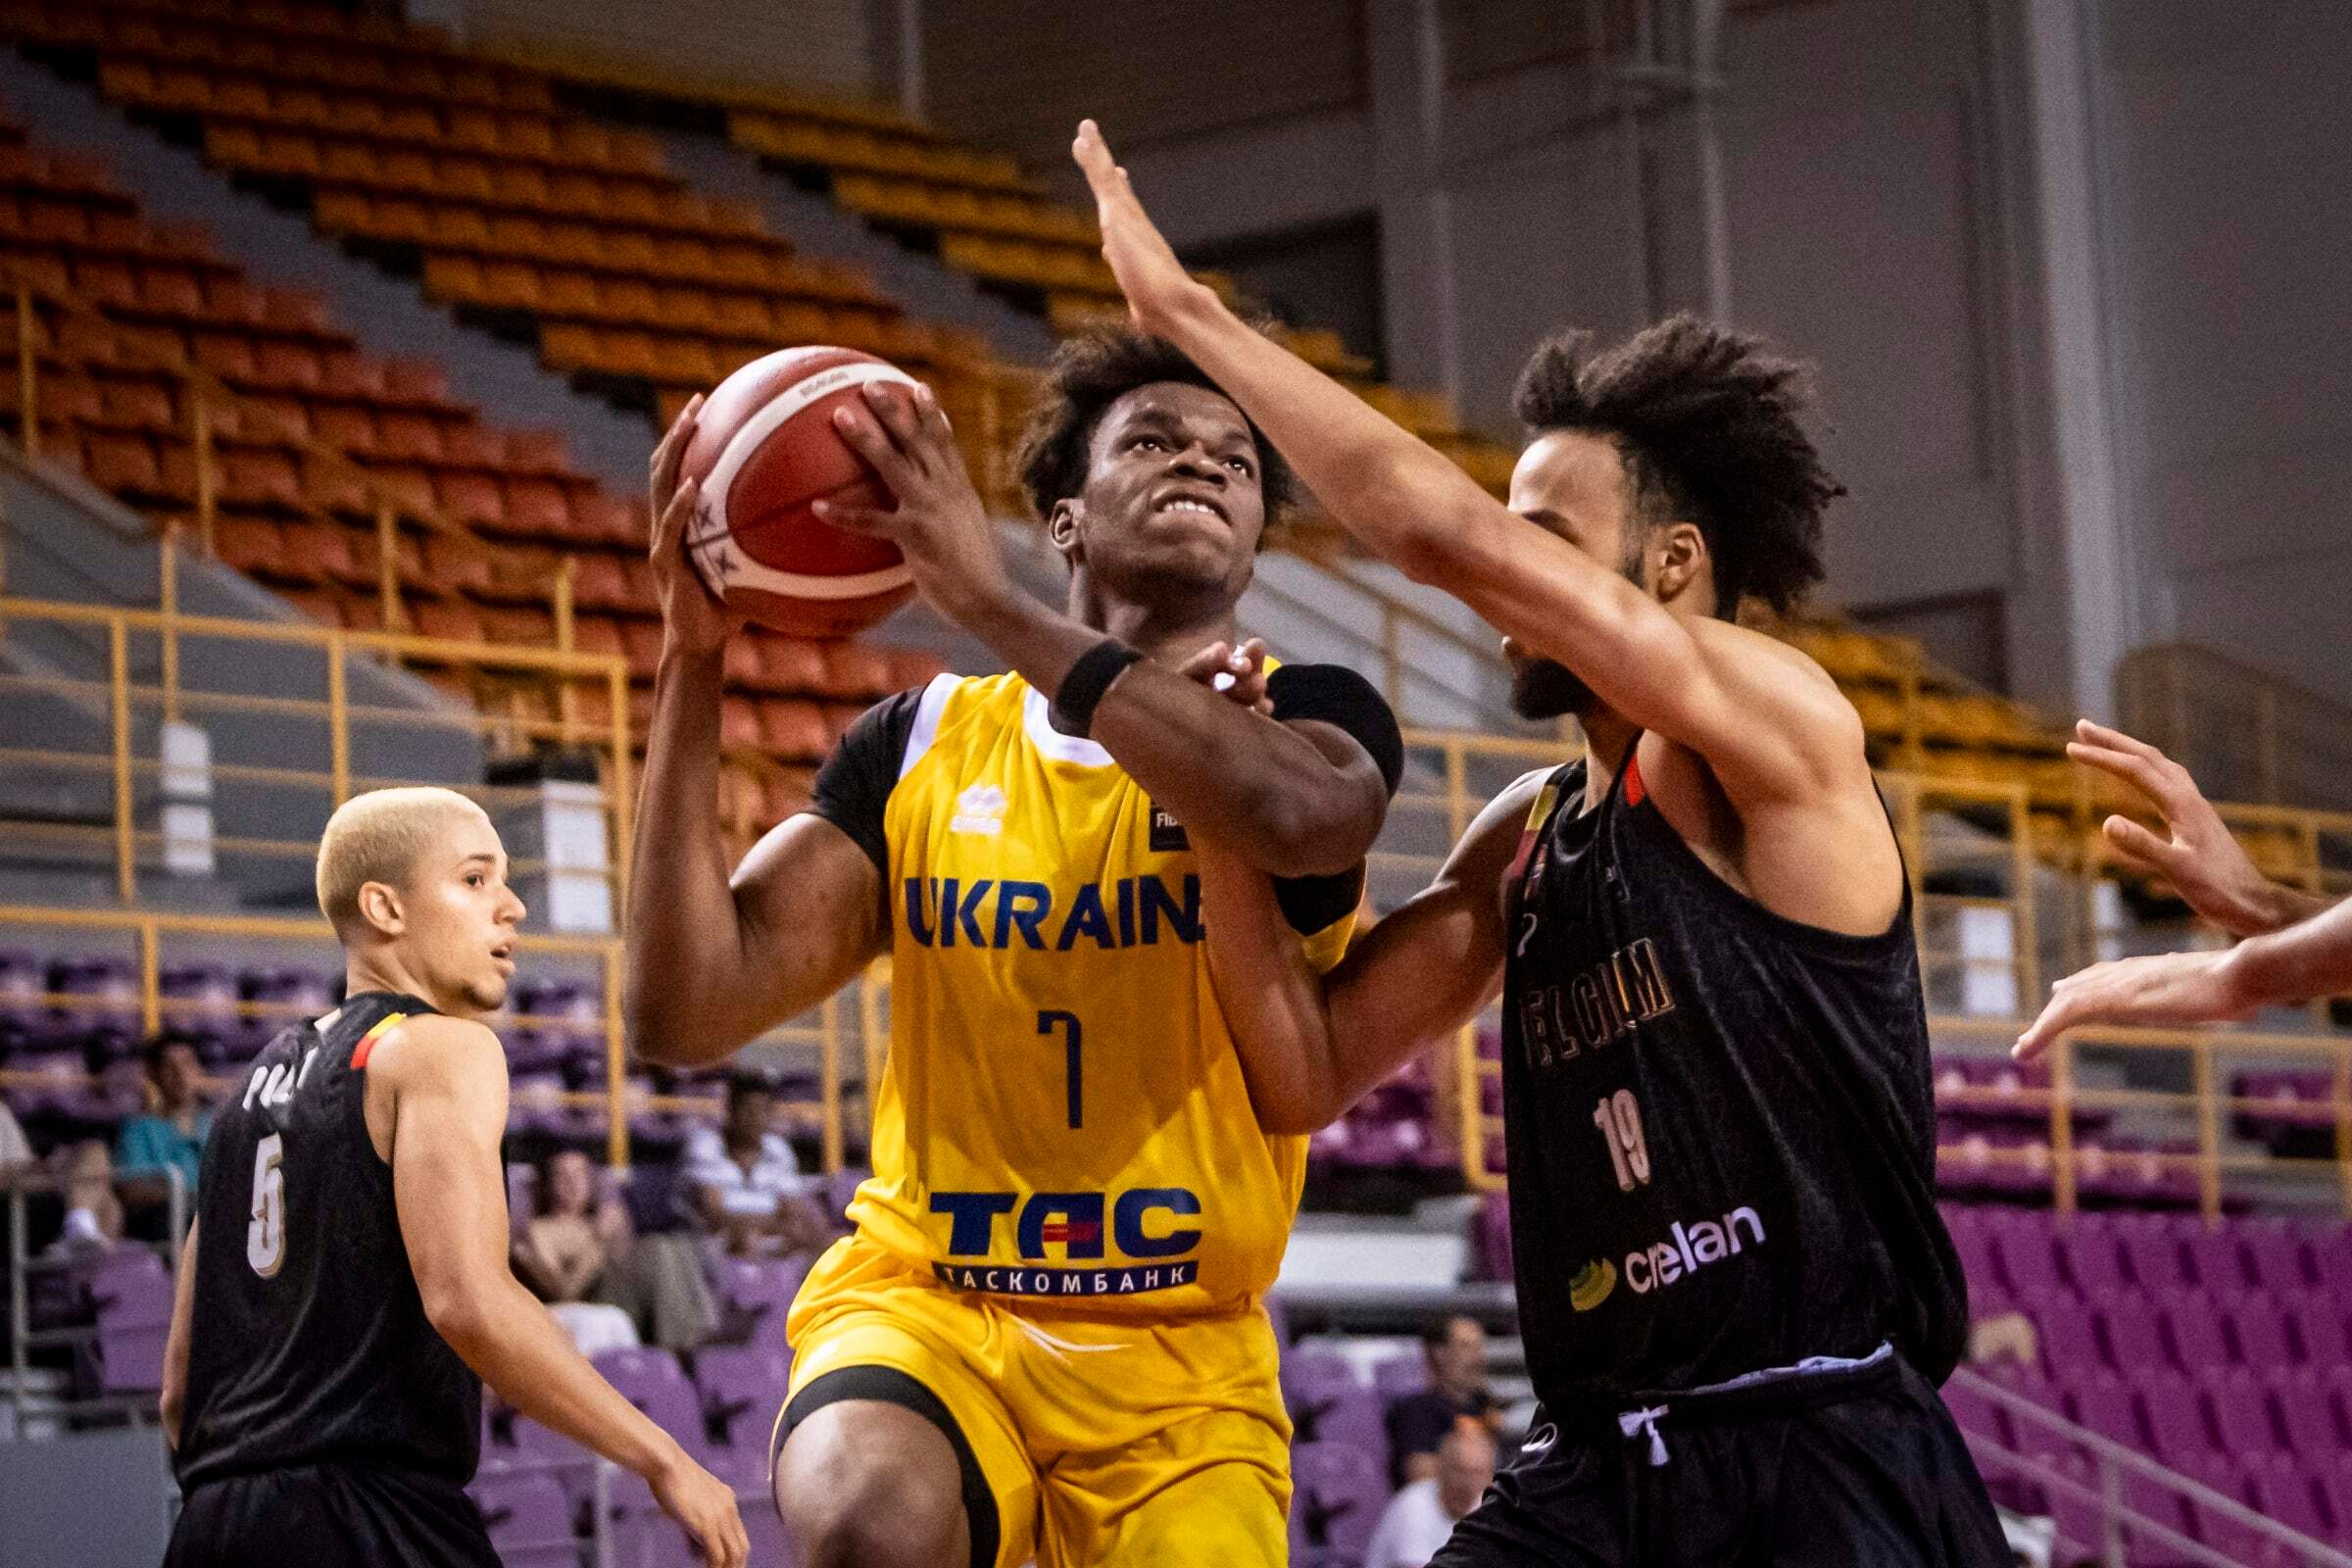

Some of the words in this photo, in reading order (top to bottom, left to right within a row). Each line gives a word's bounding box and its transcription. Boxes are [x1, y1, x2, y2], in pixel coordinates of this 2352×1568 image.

[1156, 811, 1178, 829] FIB
[904, 873, 1205, 952] UKRAIN
[1037, 1009, 1083, 1129] 7
[1593, 1089, 1651, 1193] 19
[247, 1131, 286, 1280] 5
[1625, 1205, 1766, 1295] crelan
